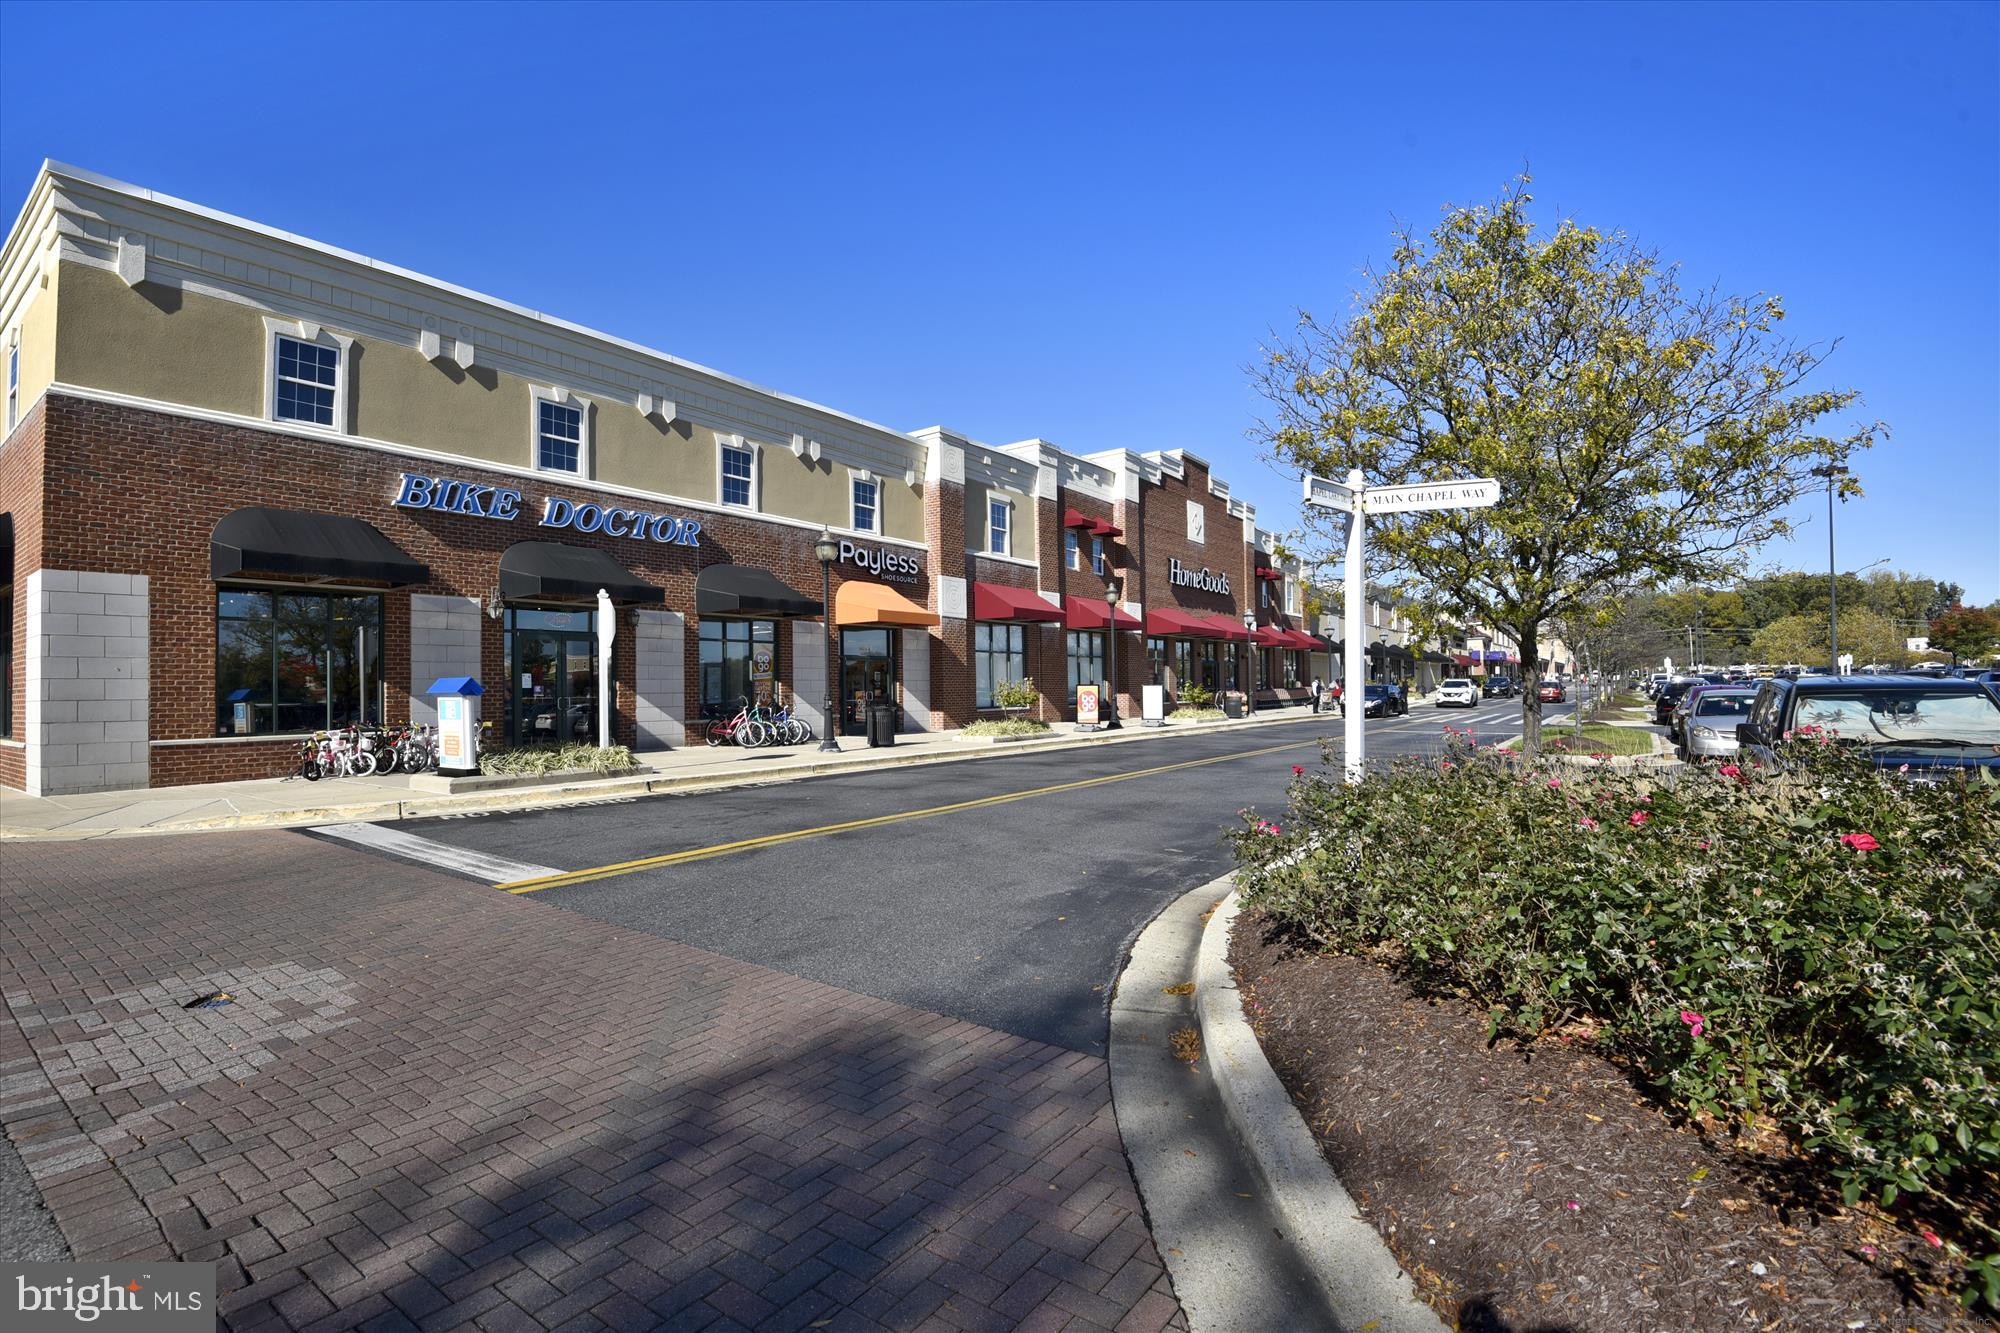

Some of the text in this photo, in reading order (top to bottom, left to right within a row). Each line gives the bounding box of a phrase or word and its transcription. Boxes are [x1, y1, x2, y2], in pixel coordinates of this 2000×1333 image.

[1373, 488, 1487, 505] MAIN CHAPEL WAY
[391, 472, 701, 547] BIKE DOCTOR
[839, 540, 919, 575] Payless
[880, 573, 918, 584] SHOESOURCE
[1169, 557, 1230, 595] HomeGoods
[757, 655, 769, 663] bo
[757, 663, 769, 672] go
[1081, 694, 1095, 703] bo
[1081, 702, 1095, 712] go
